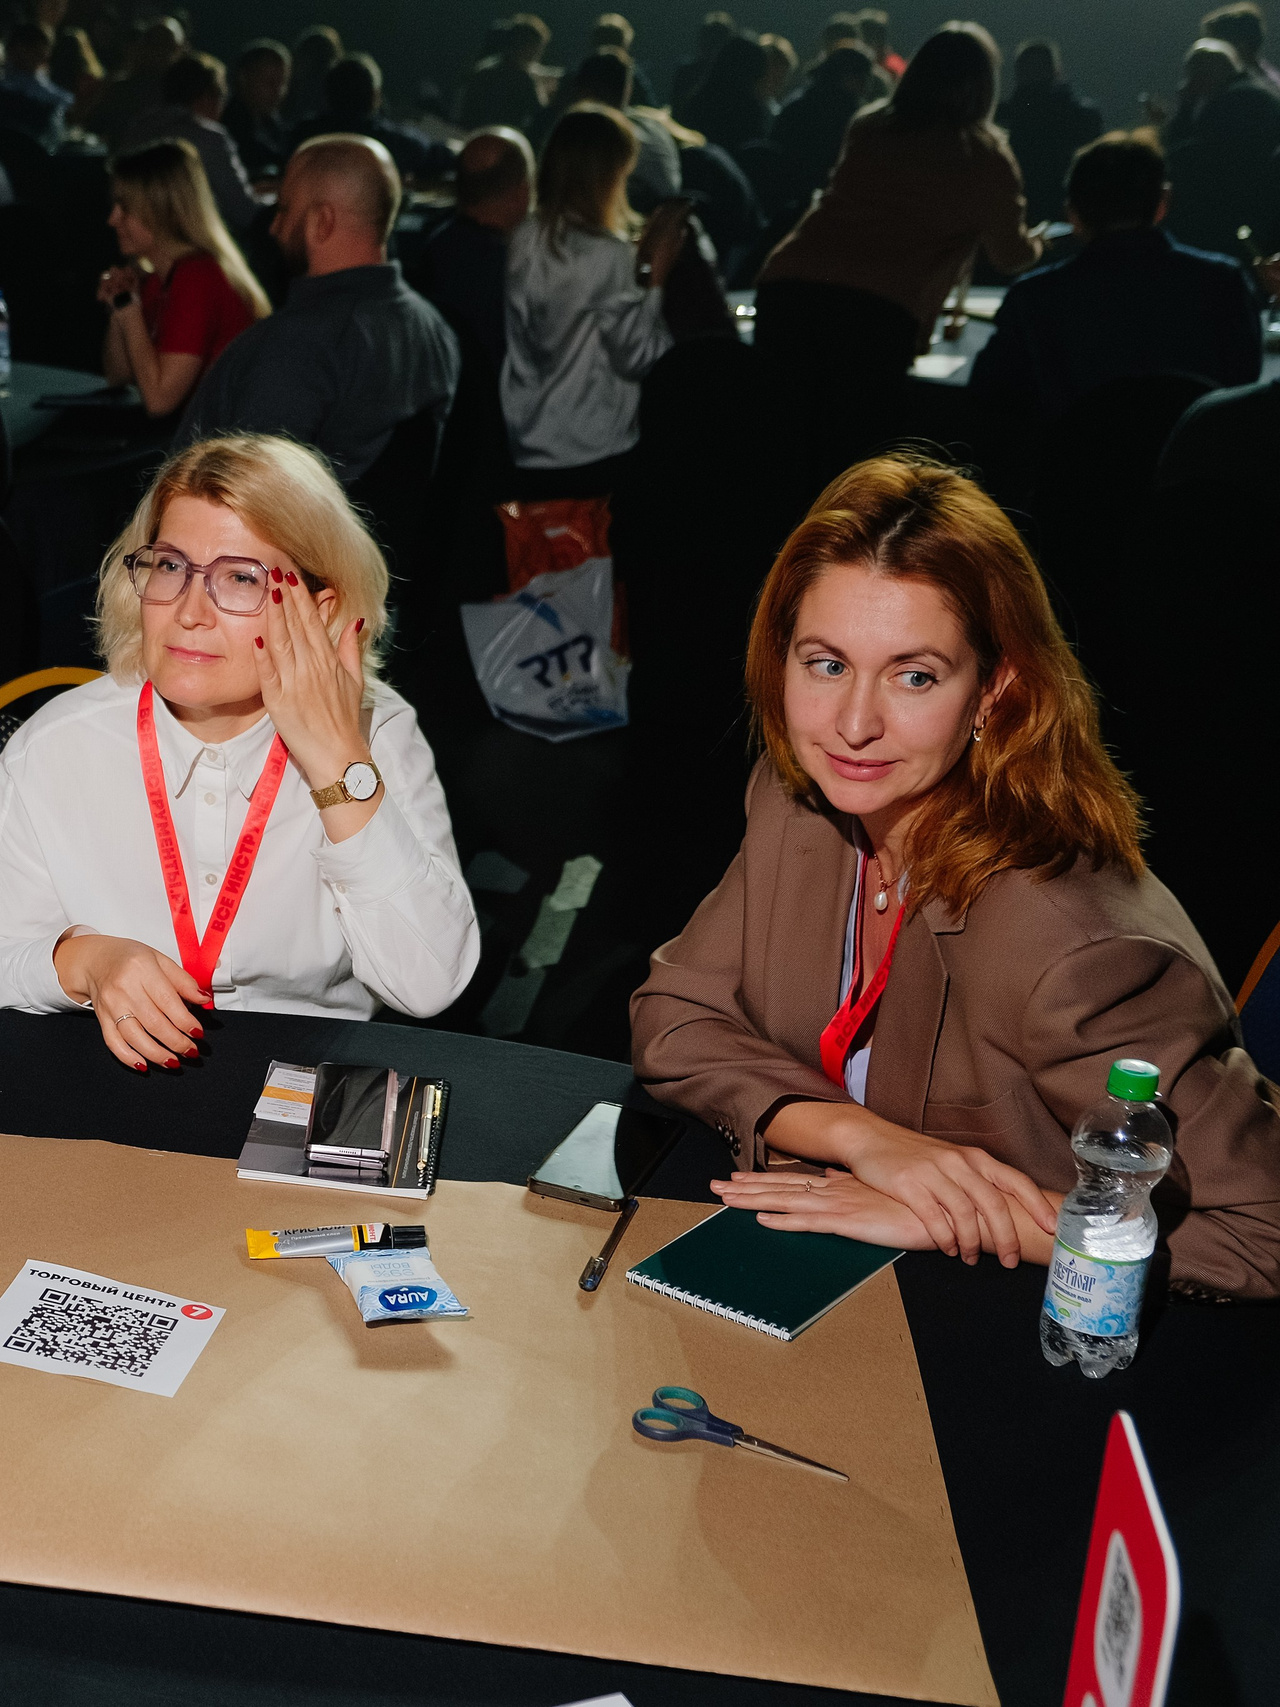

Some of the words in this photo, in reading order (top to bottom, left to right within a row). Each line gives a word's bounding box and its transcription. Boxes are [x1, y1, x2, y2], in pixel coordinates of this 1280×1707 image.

[211, 896, 235, 933] ВСЕ
[834, 1011, 858, 1051] ВСЕ
[29, 1268, 120, 1295] ТОРГОВЫЙ
[123, 1292, 177, 1309] ЦЕНТР
[385, 1290, 429, 1306] AURA
